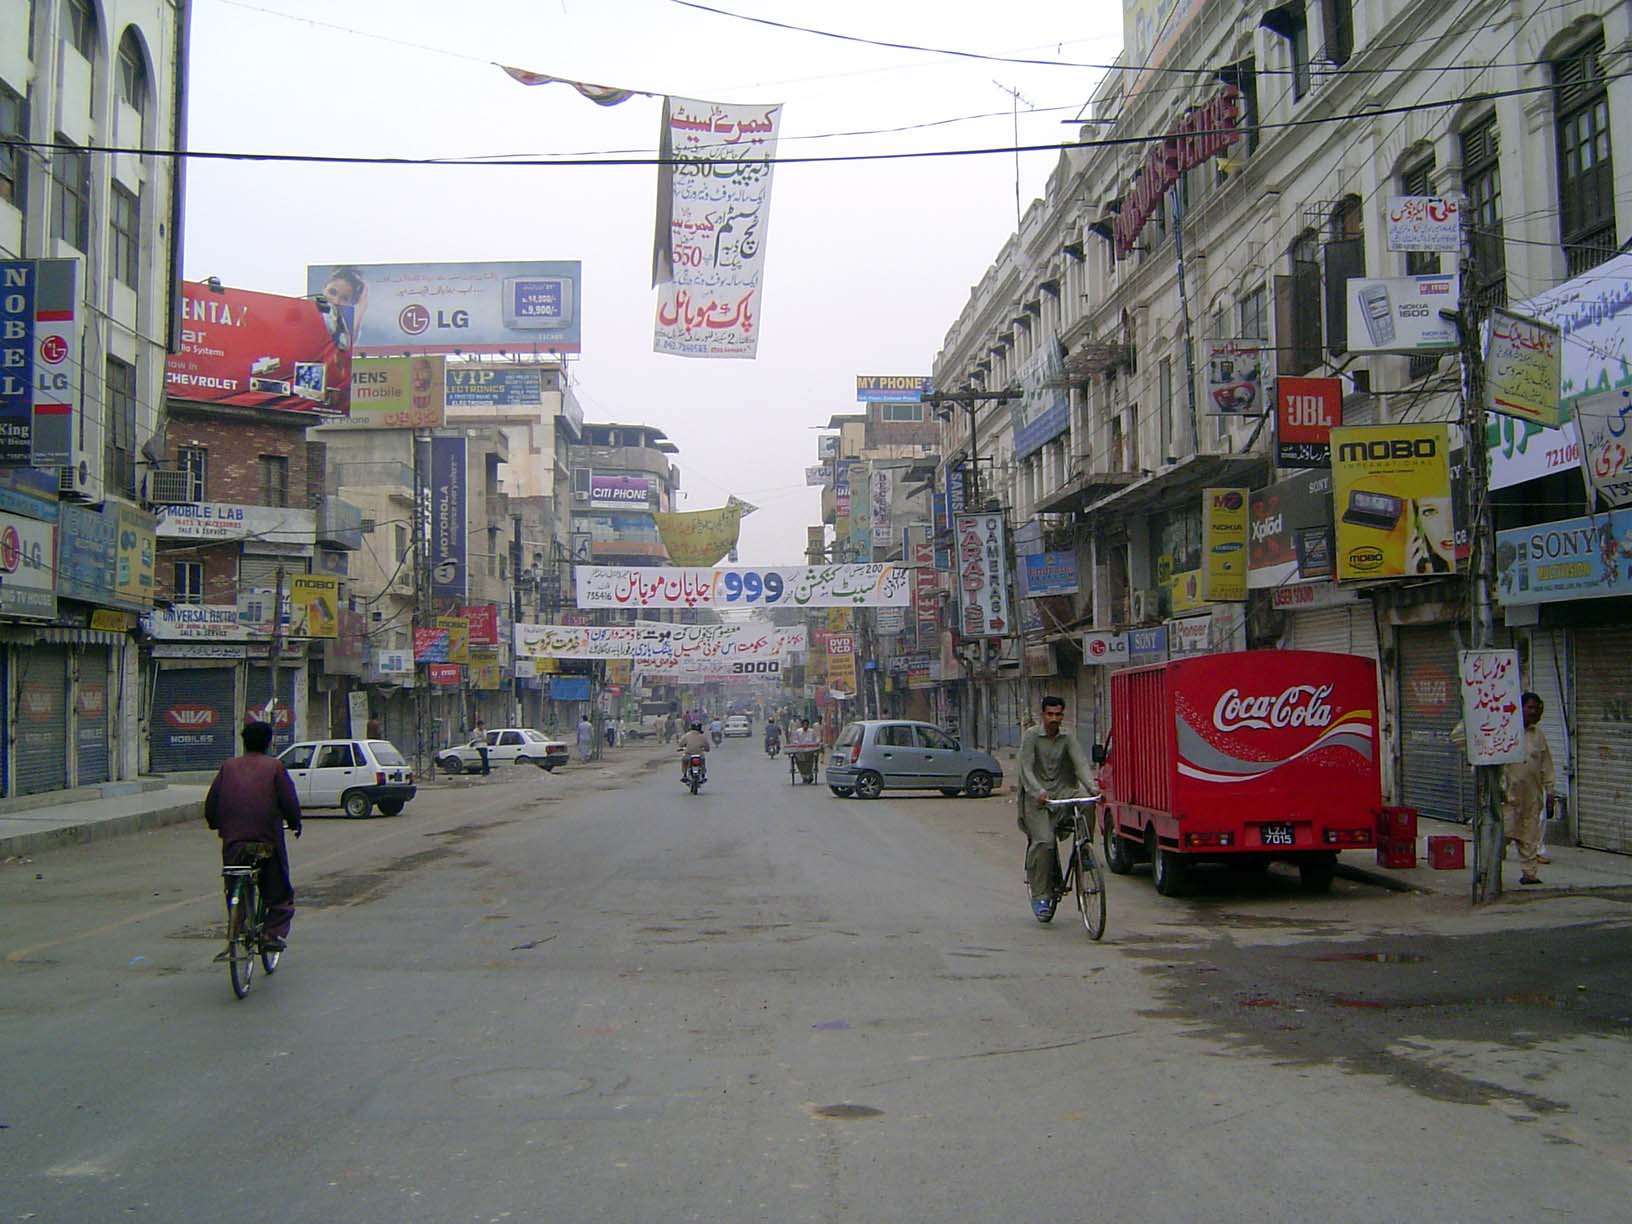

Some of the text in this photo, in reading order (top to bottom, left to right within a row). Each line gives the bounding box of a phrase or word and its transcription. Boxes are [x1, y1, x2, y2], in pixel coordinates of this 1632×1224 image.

[438, 311, 469, 328] LG
[2, 268, 29, 395] NOBEL
[193, 345, 225, 357] Systems
[39, 373, 68, 390] LG
[451, 370, 495, 385] VIP
[858, 377, 922, 389] MY PHONE
[1287, 396, 1331, 426] JBL
[593, 488, 647, 499] CITI PHONE
[168, 505, 244, 520] MOBILE LAB
[440, 486, 449, 557] MOTOROLA
[1531, 530, 1595, 561] SONY
[23, 540, 41, 569] LG
[866, 564, 883, 574] 200
[960, 519, 985, 634] PARADISE
[615, 571, 665, 605] موبائل
[664, 571, 710, 607] جاپان
[723, 571, 784, 603] 999
[918, 546, 935, 622] KENTX
[738, 635, 768, 653] حکومت
[830, 638, 850, 646] DVD
[831, 645, 851, 654] VCD
[1109, 641, 1125, 652] LG
[733, 661, 779, 674] 3000
[1213, 683, 1334, 732] Coca-Cola
[169, 710, 213, 724] VIVA
[171, 735, 214, 744] MOBILES
[1264, 834, 1292, 845] 7015
